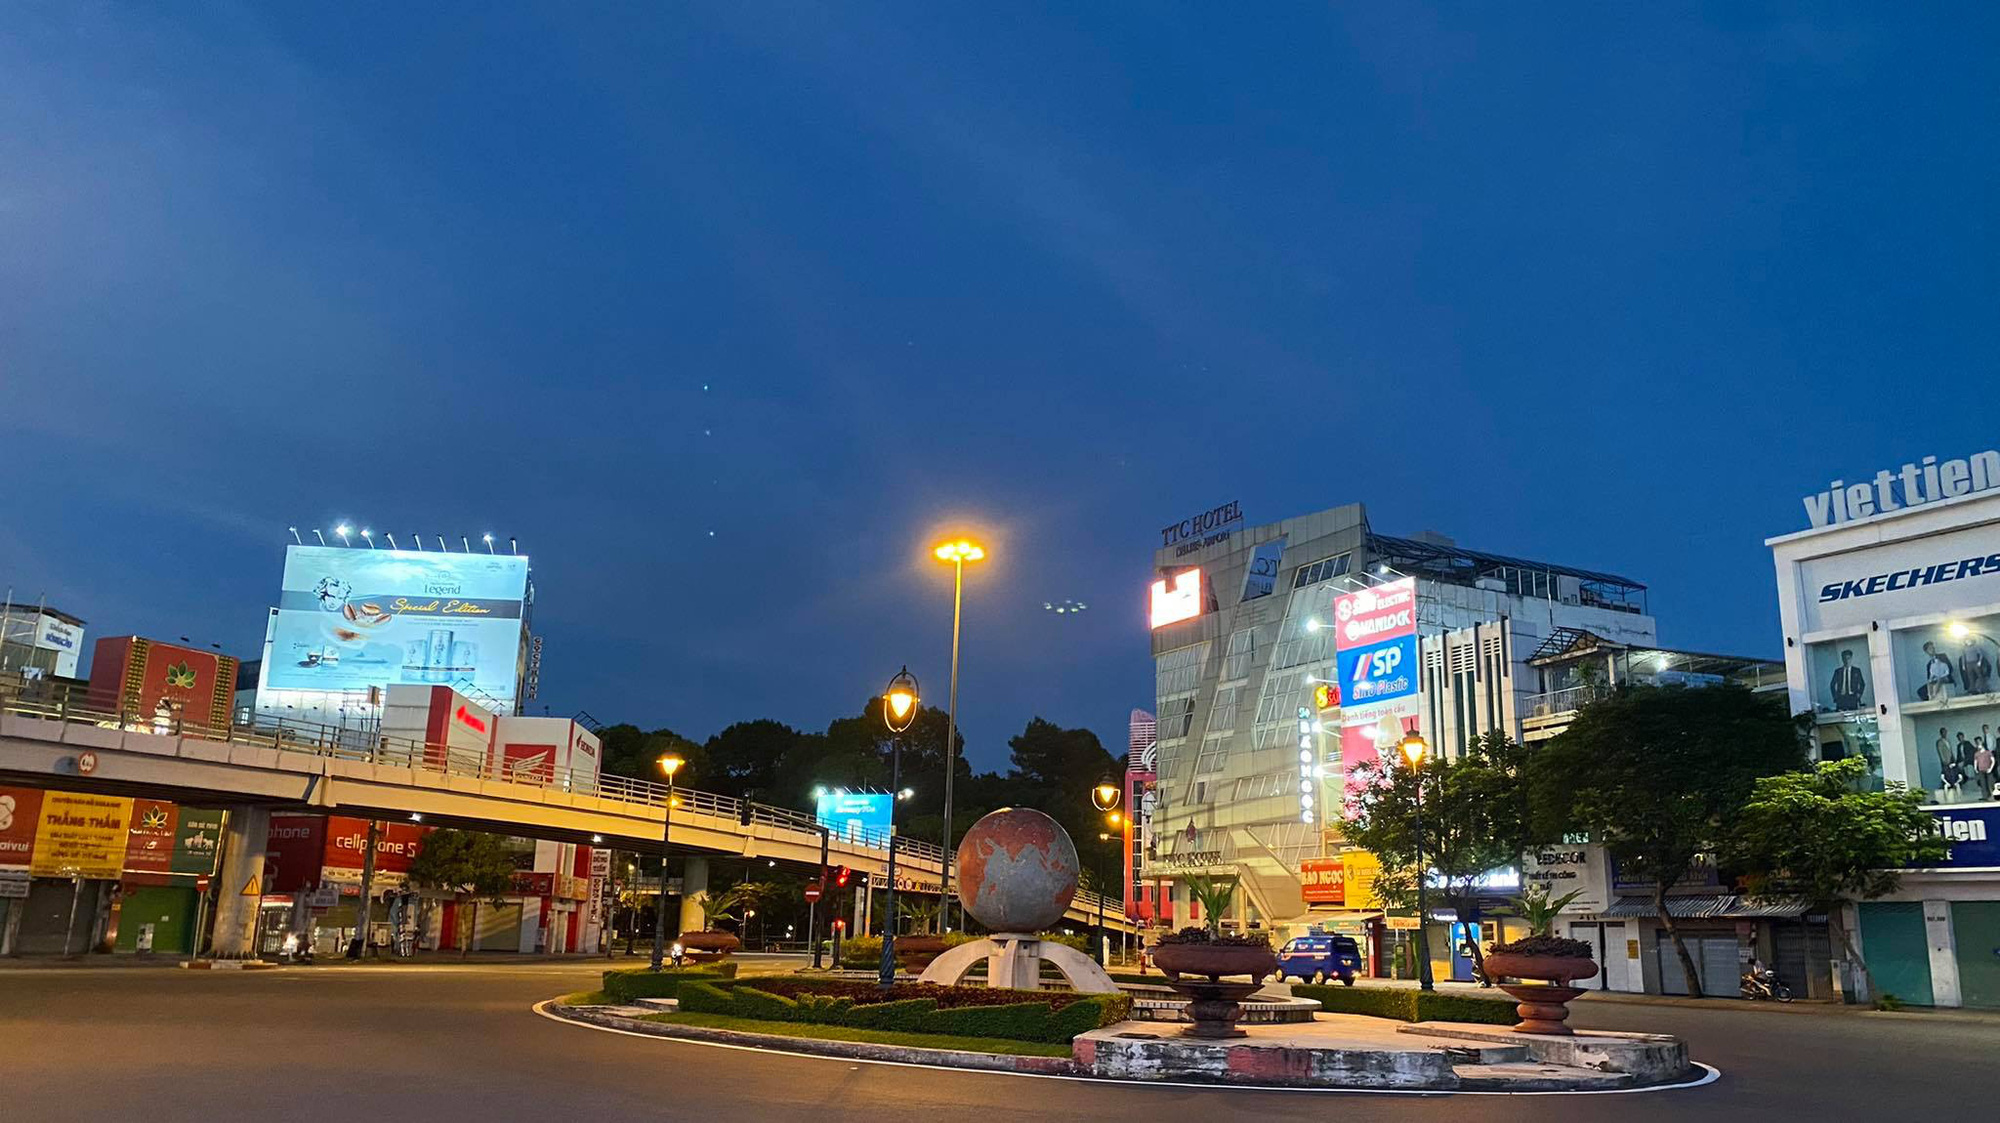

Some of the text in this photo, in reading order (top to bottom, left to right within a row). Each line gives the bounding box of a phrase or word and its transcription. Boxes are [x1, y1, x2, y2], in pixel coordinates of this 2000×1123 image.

[1803, 449, 2000, 529] viettien
[1161, 499, 1243, 546] TTC HOTEL
[424, 583, 461, 596] Legend
[1818, 552, 2000, 603] SKECHERS
[390, 597, 491, 615] Special Edition
[1372, 645, 1402, 678] SP
[1376, 675, 1409, 696] Plastic
[336, 833, 404, 855] cellpone
[1301, 863, 1318, 885] BẢO
[1319, 869, 1344, 890] NGỌC
